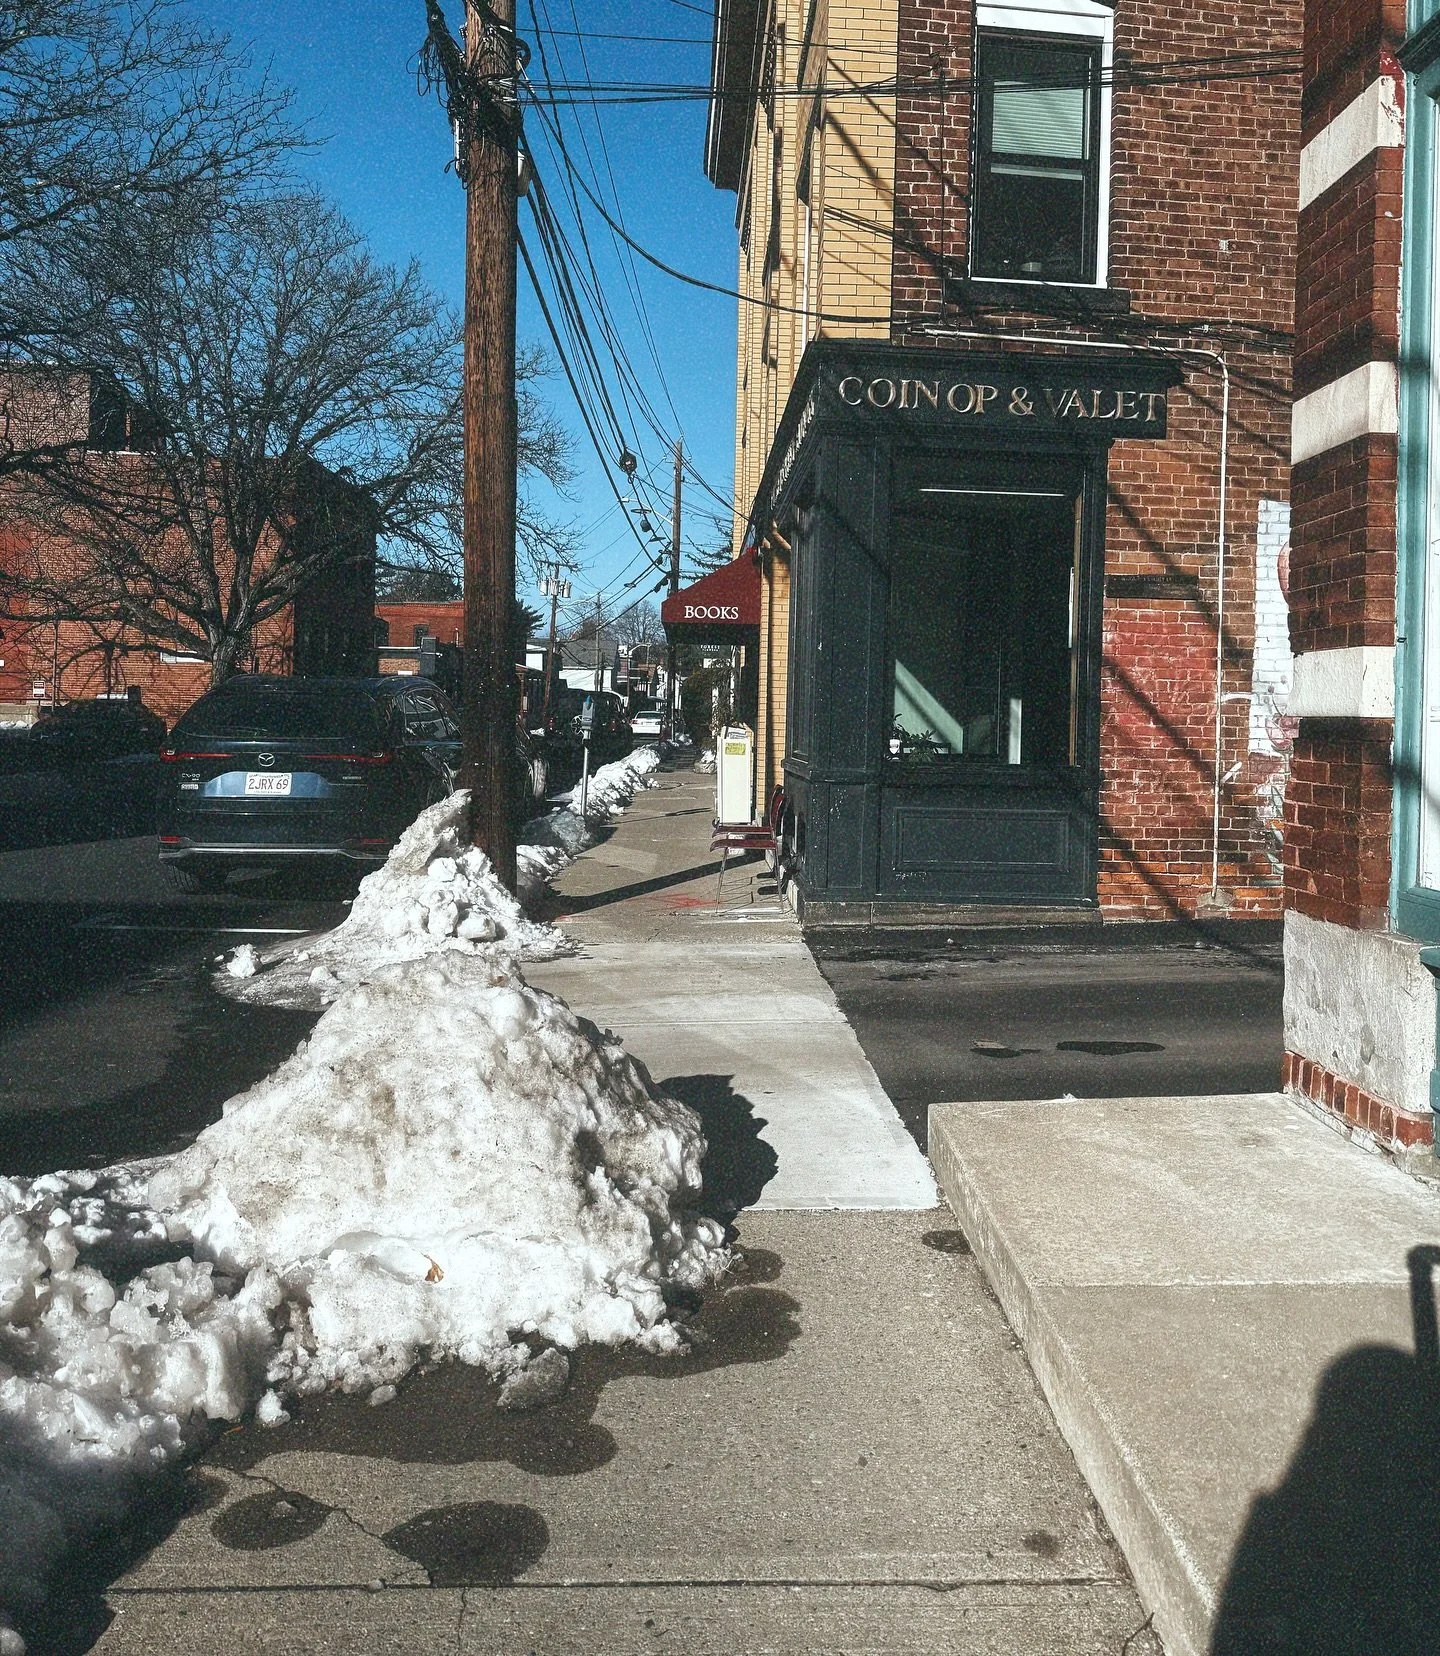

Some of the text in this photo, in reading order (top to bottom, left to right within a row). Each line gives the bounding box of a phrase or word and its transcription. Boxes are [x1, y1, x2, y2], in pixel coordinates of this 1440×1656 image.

[838, 376, 1166, 422] COIN OP & VALET
[684, 605, 739, 620] BOOKS
[248, 778, 289, 790] 2JRX 69
